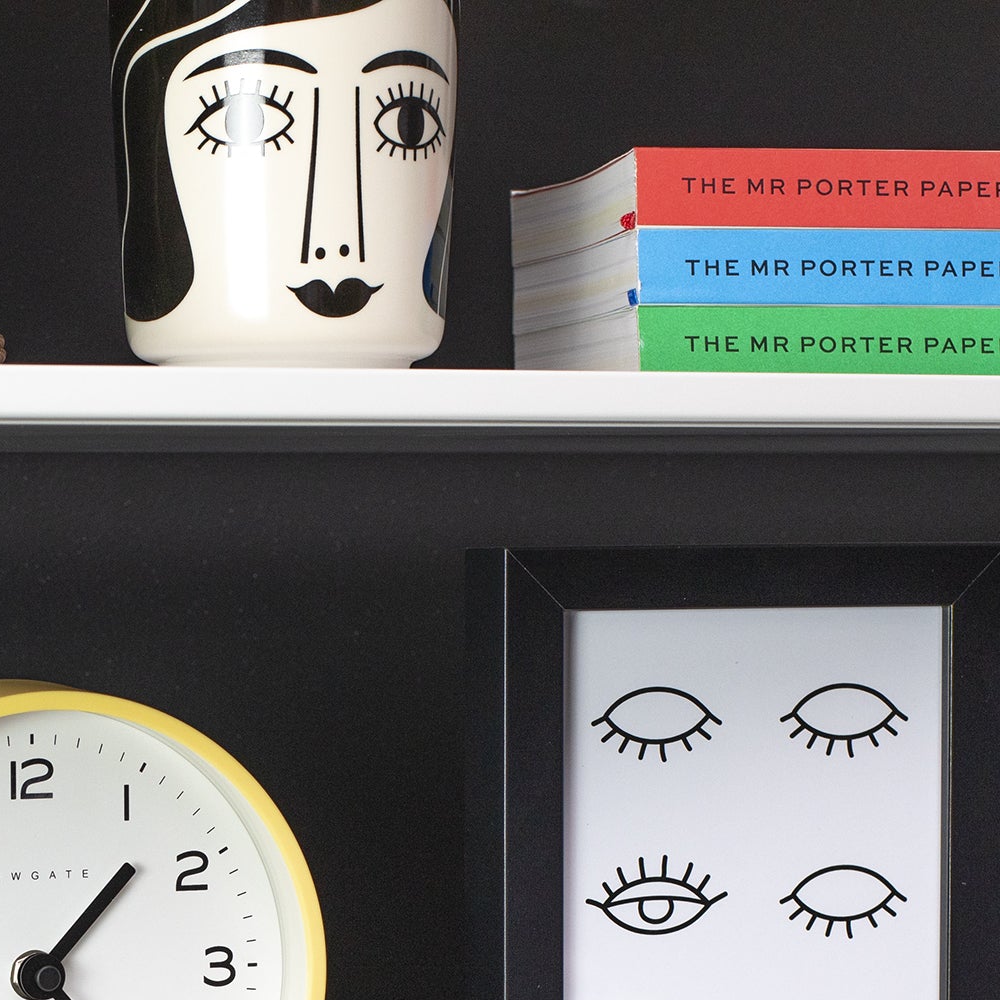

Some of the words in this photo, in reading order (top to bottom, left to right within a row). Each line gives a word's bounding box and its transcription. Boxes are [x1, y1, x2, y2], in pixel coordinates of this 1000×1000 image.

[682, 178, 735, 194] THE
[748, 179, 784, 195] MR
[798, 179, 909, 196] PORTER
[685, 260, 739, 276] THE
[751, 260, 789, 276] MR
[802, 260, 912, 276] PORTER
[925, 261, 1000, 277] PAPE
[685, 336, 739, 352] THE
[751, 336, 789, 352] MR
[801, 337, 912, 353] PORTER
[925, 338, 1000, 354] PAPE
[10, 757, 54, 800] 12
[123, 784, 131, 822] 1
[175, 850, 209, 892] 2
[203, 945, 236, 987] 3
